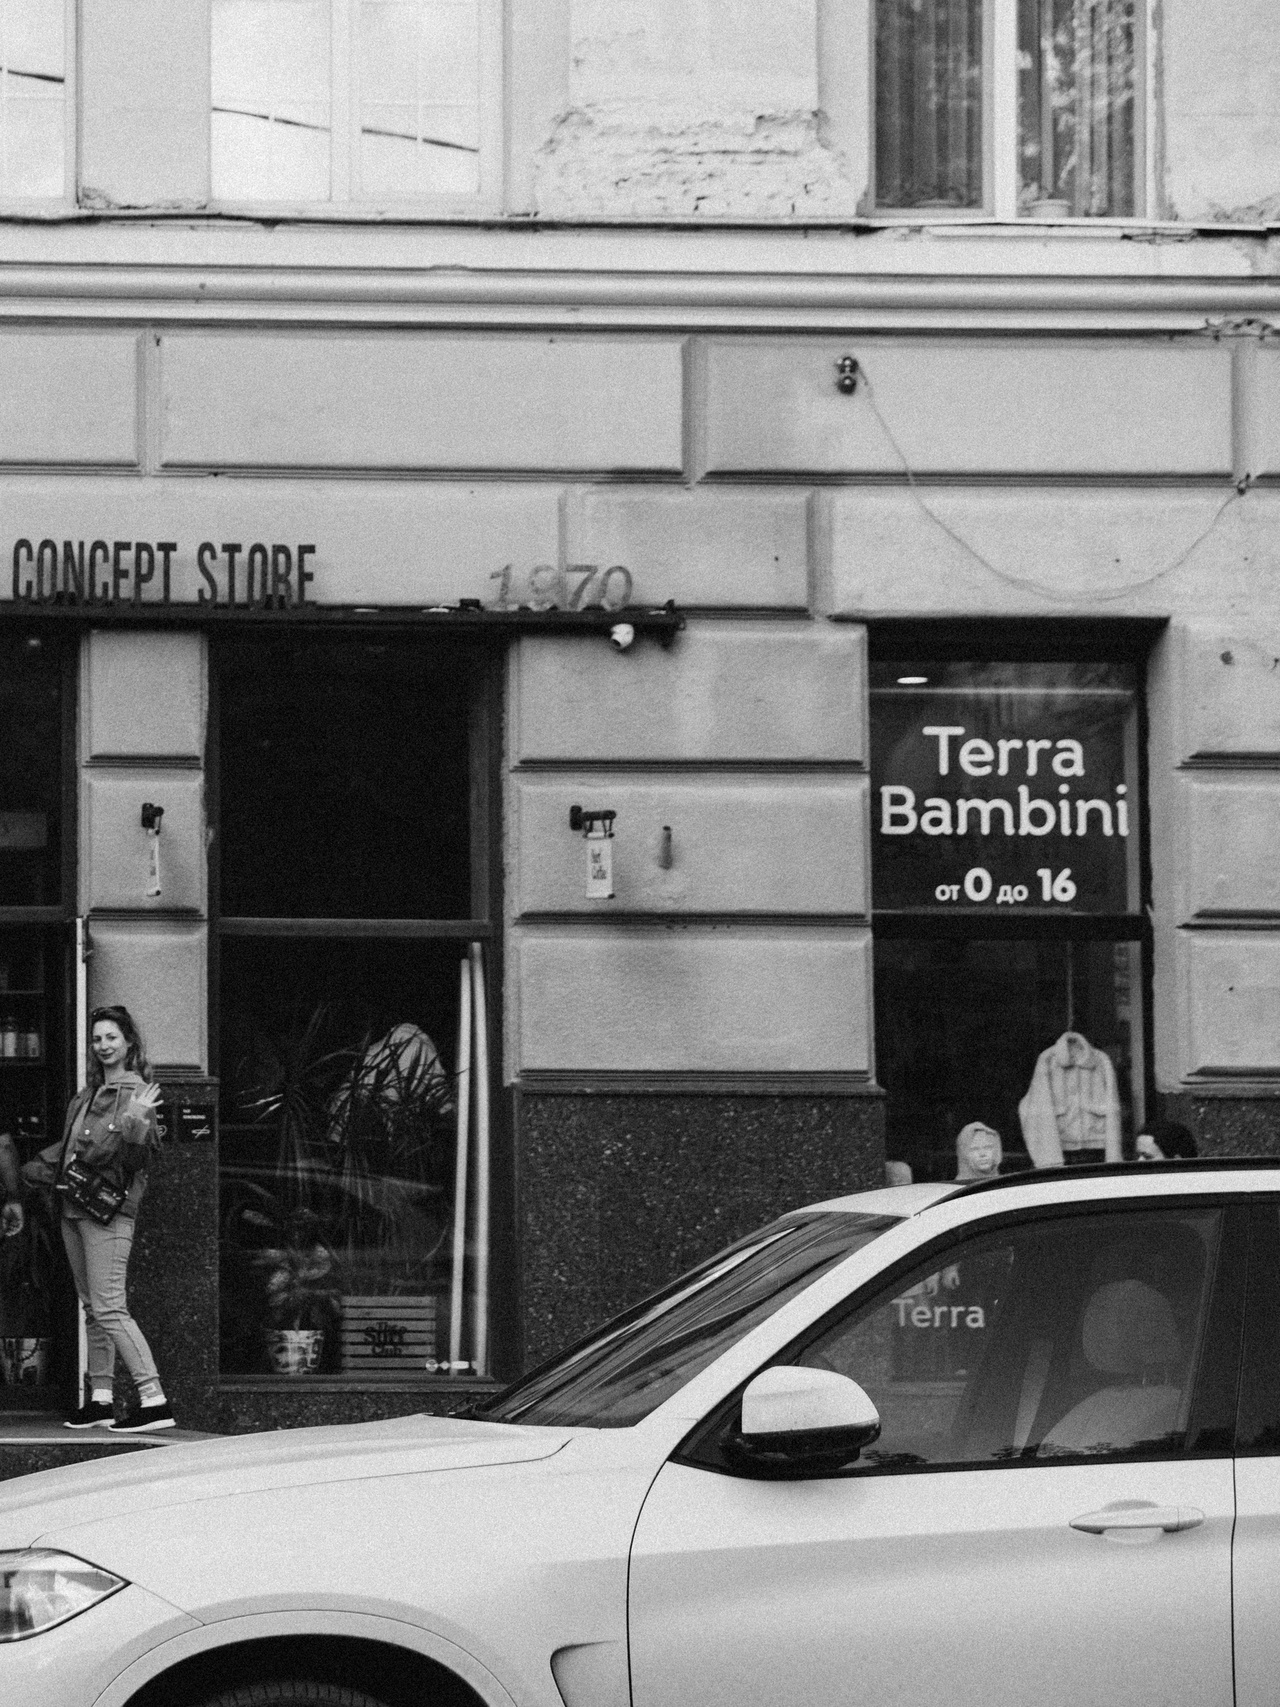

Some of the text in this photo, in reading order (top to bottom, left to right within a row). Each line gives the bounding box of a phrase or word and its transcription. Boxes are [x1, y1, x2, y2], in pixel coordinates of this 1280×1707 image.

[13, 538, 177, 603] CONCEPT
[197, 541, 316, 604] STORE
[922, 726, 1085, 777] Terra
[880, 784, 1129, 836] Bambini
[935, 867, 1077, 904] от 0 до 16
[891, 1298, 985, 1328] Terra
